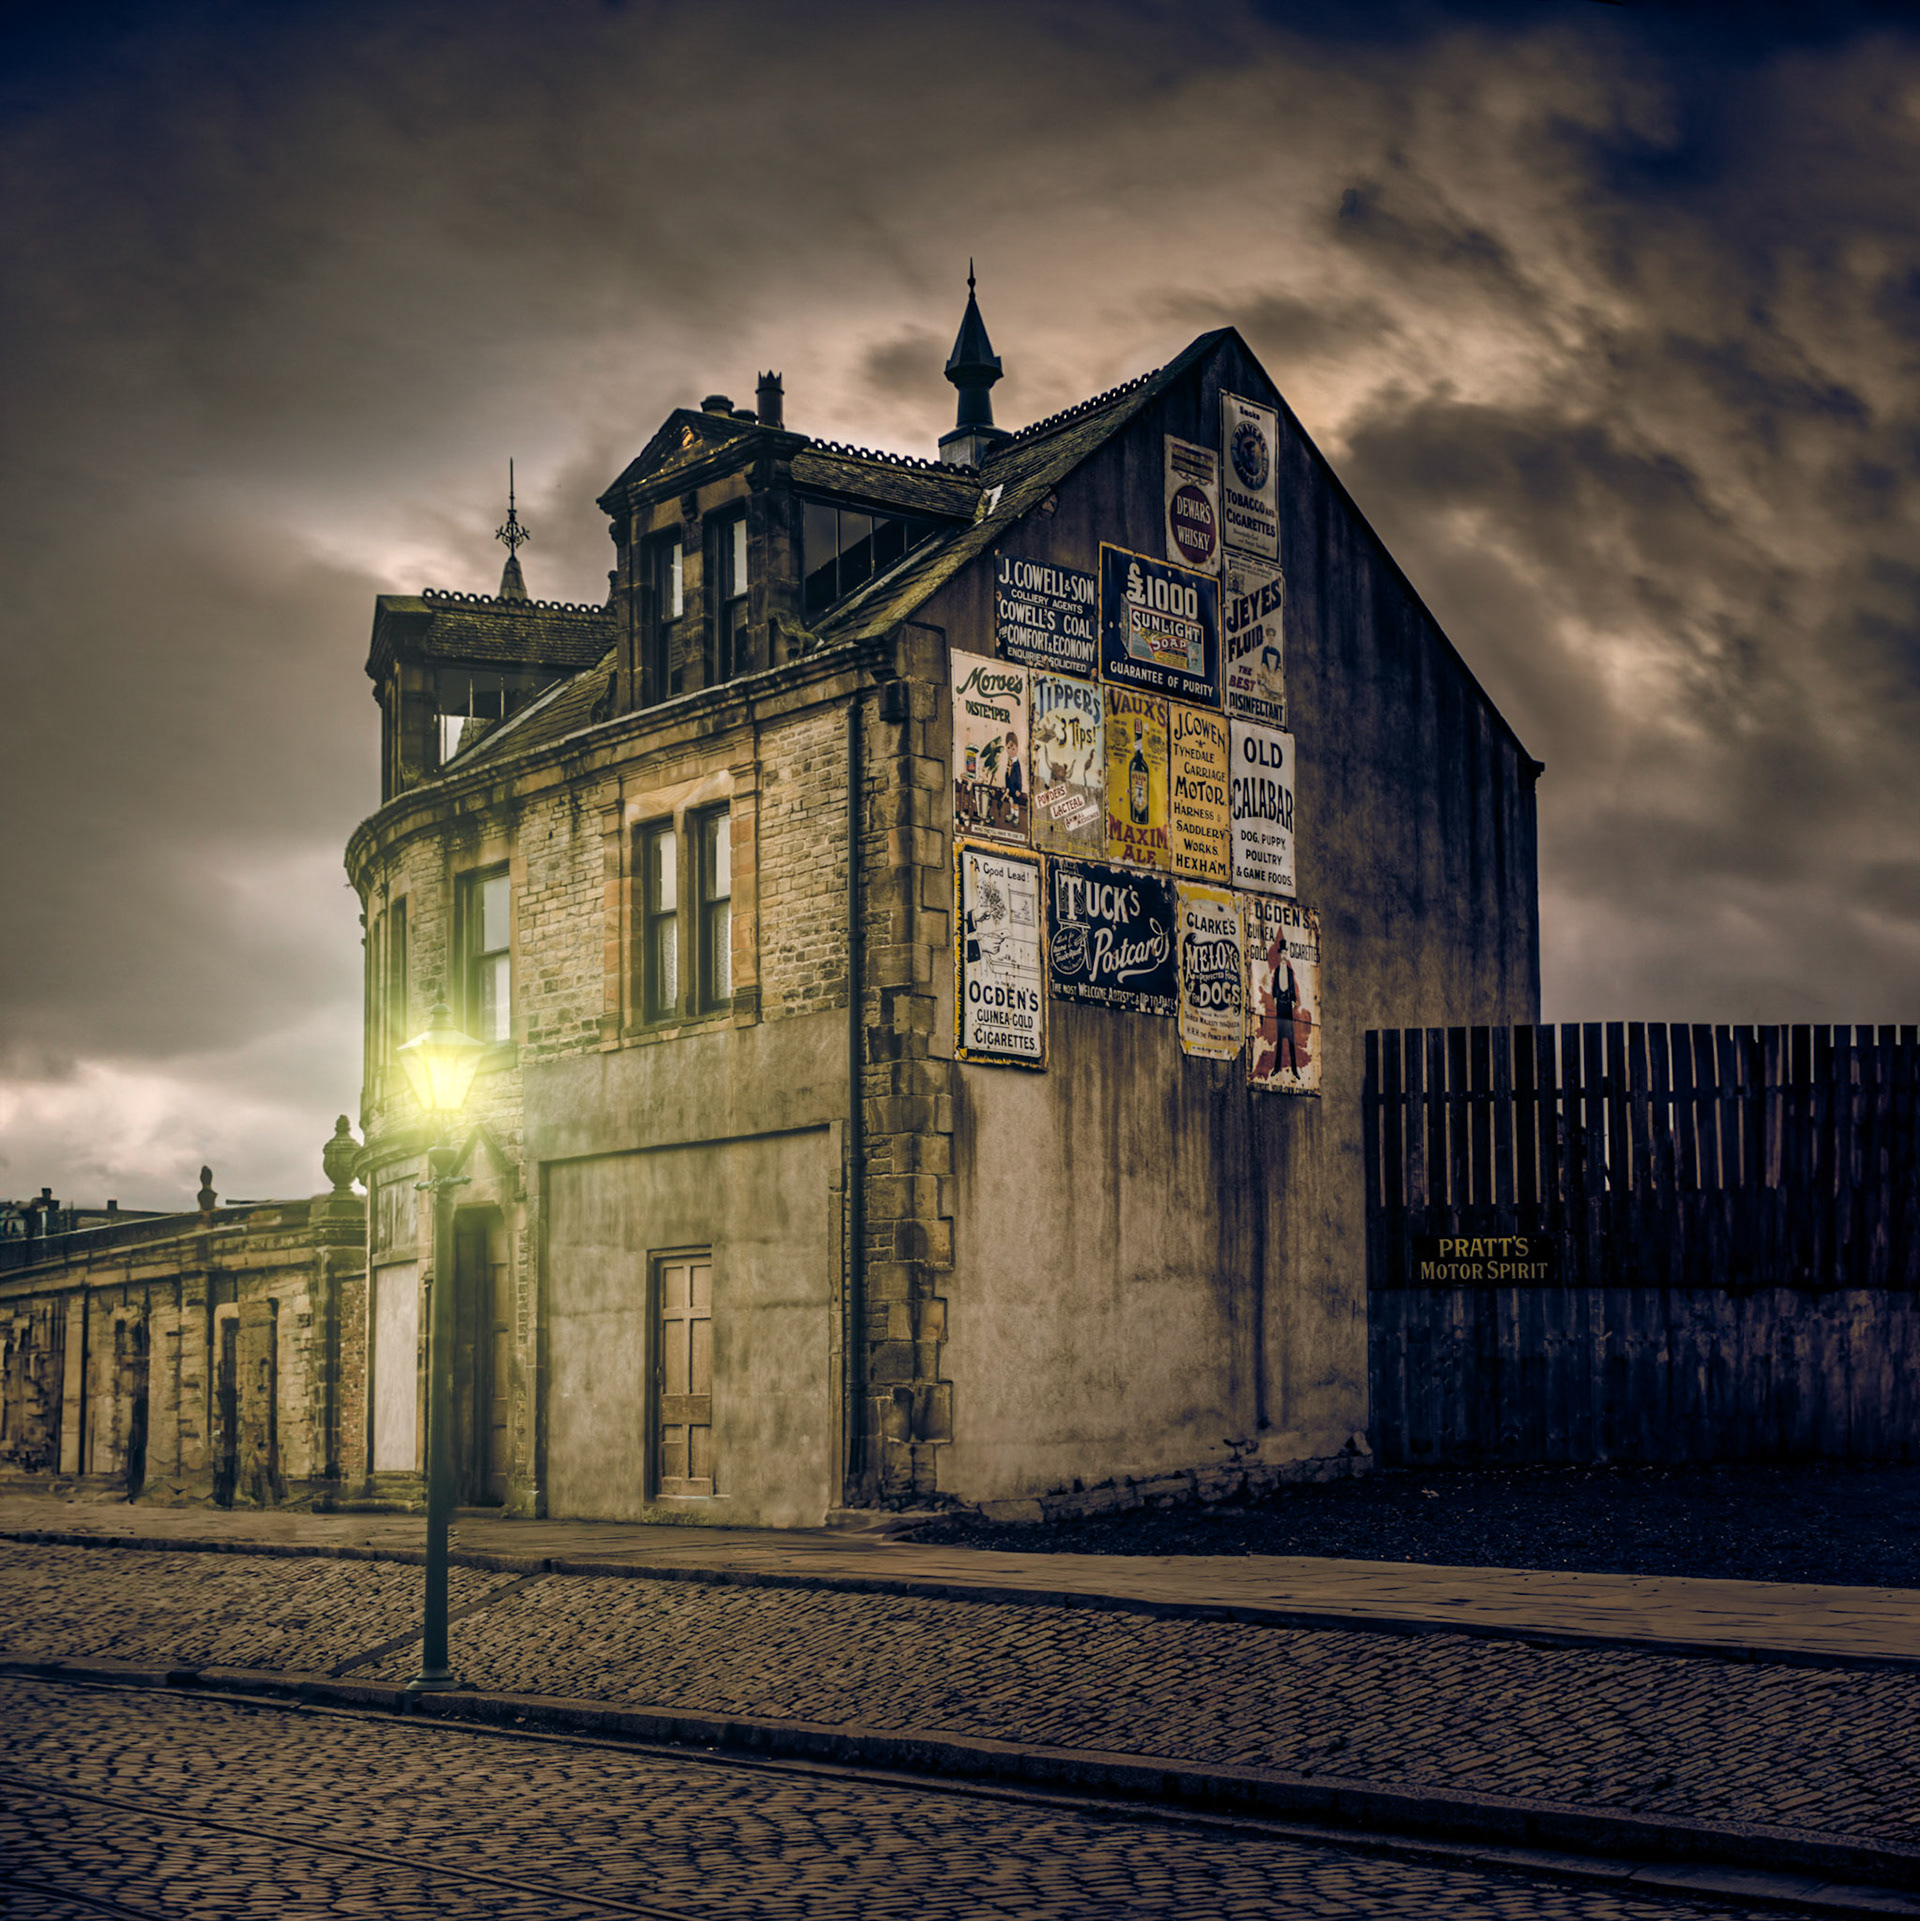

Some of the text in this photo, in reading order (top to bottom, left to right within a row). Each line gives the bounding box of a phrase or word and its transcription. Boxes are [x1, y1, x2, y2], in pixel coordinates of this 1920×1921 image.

[1176, 494, 1211, 525] DEWAR'S
[1226, 487, 1265, 515] TOBACCO
[1226, 508, 1276, 538] CIGARETTES
[1177, 525, 1210, 552] WHISKY
[1010, 588, 1084, 615] COLLIERY AGENTS
[1071, 574, 1095, 605] SON
[1126, 562, 1198, 620] £1000
[1000, 599, 1056, 631] COWELL'S
[1063, 614, 1094, 640] COAL
[1132, 611, 1200, 642] SUNLIGHT
[1007, 623, 1050, 652] COMFORT
[1053, 634, 1097, 662] ECONOMY
[1151, 635, 1188, 650] SOAP
[1227, 624, 1264, 664] FLUID
[1007, 646, 1088, 673] ENQUIRIE SOLICITED
[1238, 665, 1253, 676] THE
[1110, 661, 1214, 697] GUARANTEE OF PURITY
[1228, 675, 1256, 692] BEST
[1034, 677, 1101, 725] TIPPER'S
[1229, 692, 1283, 721] DISINFECTANT
[1173, 743, 1215, 764] TYNEDALE
[1243, 736, 1283, 769] OLD
[1052, 796, 1083, 818] LACTEAL
[1174, 801, 1215, 821] HARNESS
[1232, 777, 1293, 833] CALABAR
[1108, 812, 1169, 850] MAXIM
[1176, 819, 1225, 840] SADDLERY
[1122, 844, 1157, 866] ALE
[1246, 848, 1282, 866] POULTRY
[983, 862, 1004, 878] Good
[1007, 867, 1030, 883] Lead!
[1236, 866, 1242, 877] &
[1243, 867, 1266, 882] GAME
[1059, 873, 1141, 924] TUCK'S
[1186, 912, 1237, 935] CLARKE'S
[1185, 941, 1239, 974] MELOX
[1250, 942, 1321, 964] GOLD CIGARETTES
[969, 980, 1039, 1012] OGDEN'S
[1050, 979, 1062, 993] THE
[1062, 984, 1077, 995] MOST
[1078, 981, 1107, 1000] WELCOME
[1199, 981, 1241, 1007] DOGS
[1438, 1235, 1529, 1258] PRATT'S
[1420, 1260, 1548, 1280] MOTOR SPIRIT
